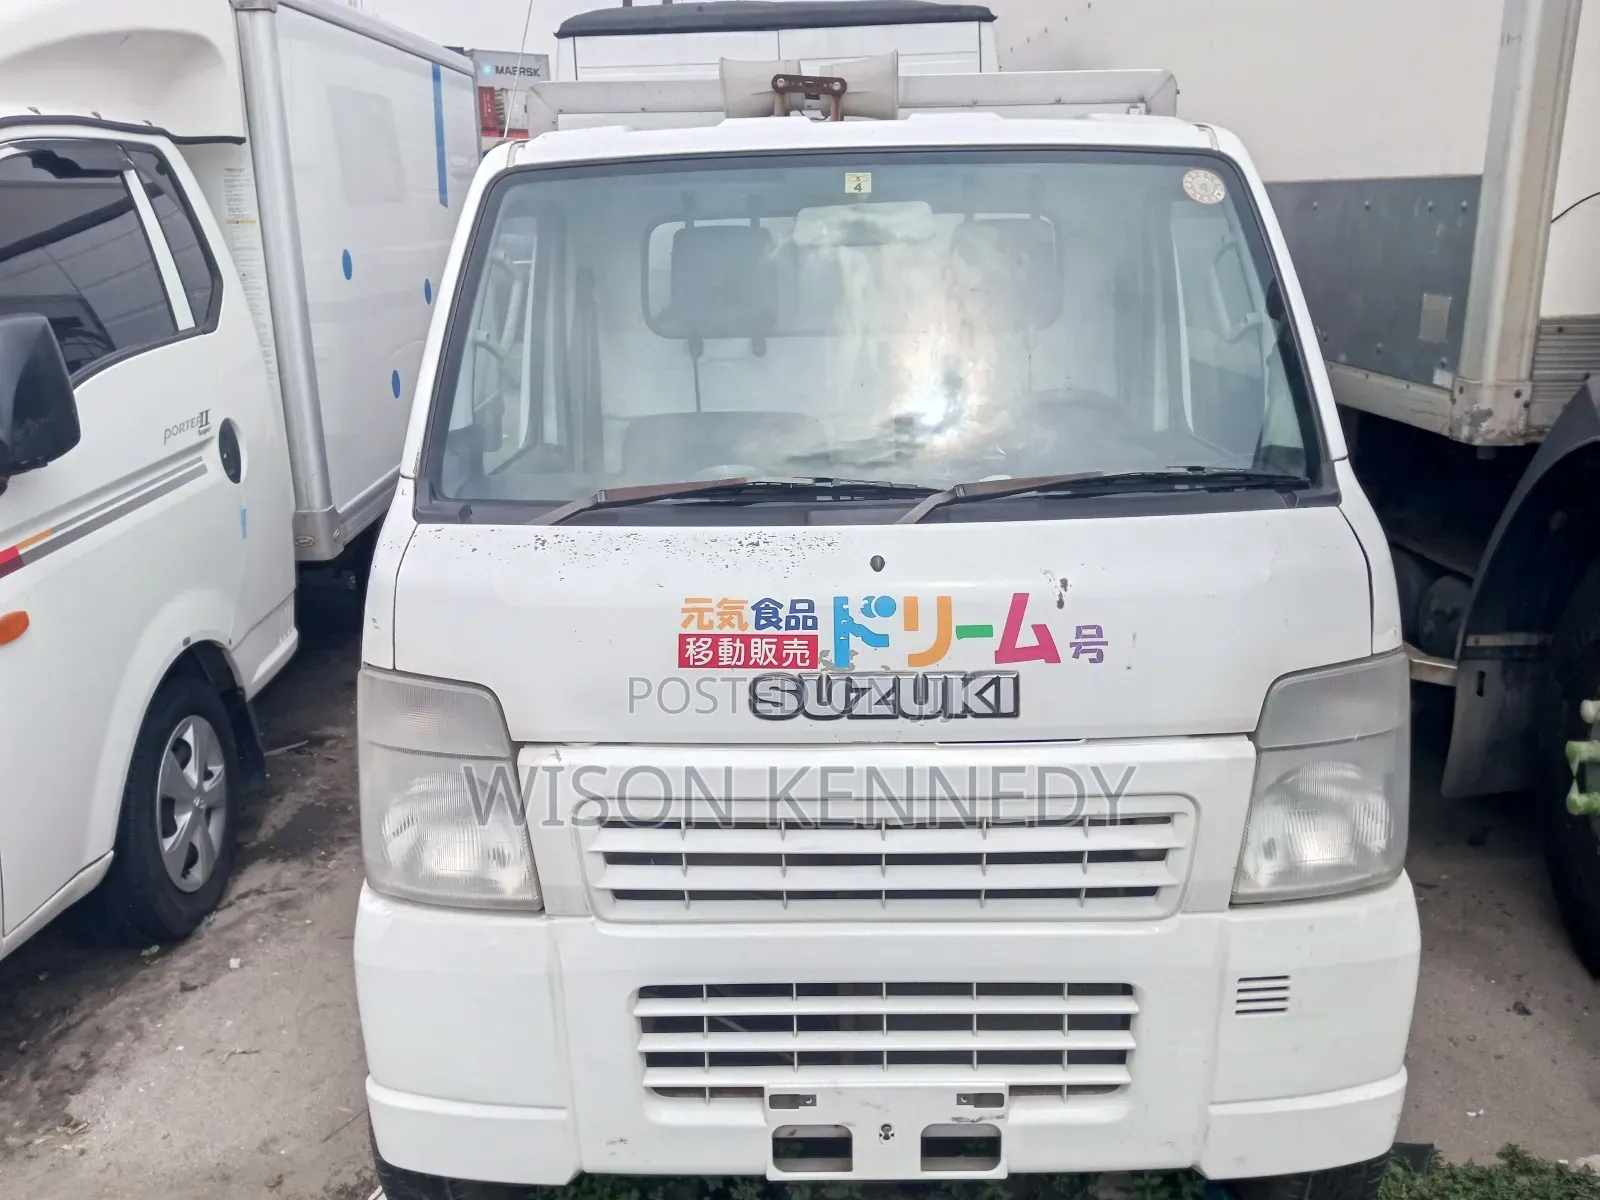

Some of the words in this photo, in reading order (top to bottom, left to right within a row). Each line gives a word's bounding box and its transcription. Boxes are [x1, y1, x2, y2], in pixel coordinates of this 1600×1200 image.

[495, 65, 541, 77] MAERSK
[854, 182, 863, 193] 4
[681, 597, 818, 631] 元気食品
[685, 637, 810, 666] 移動販売
[748, 671, 1021, 722] SUZUKI
